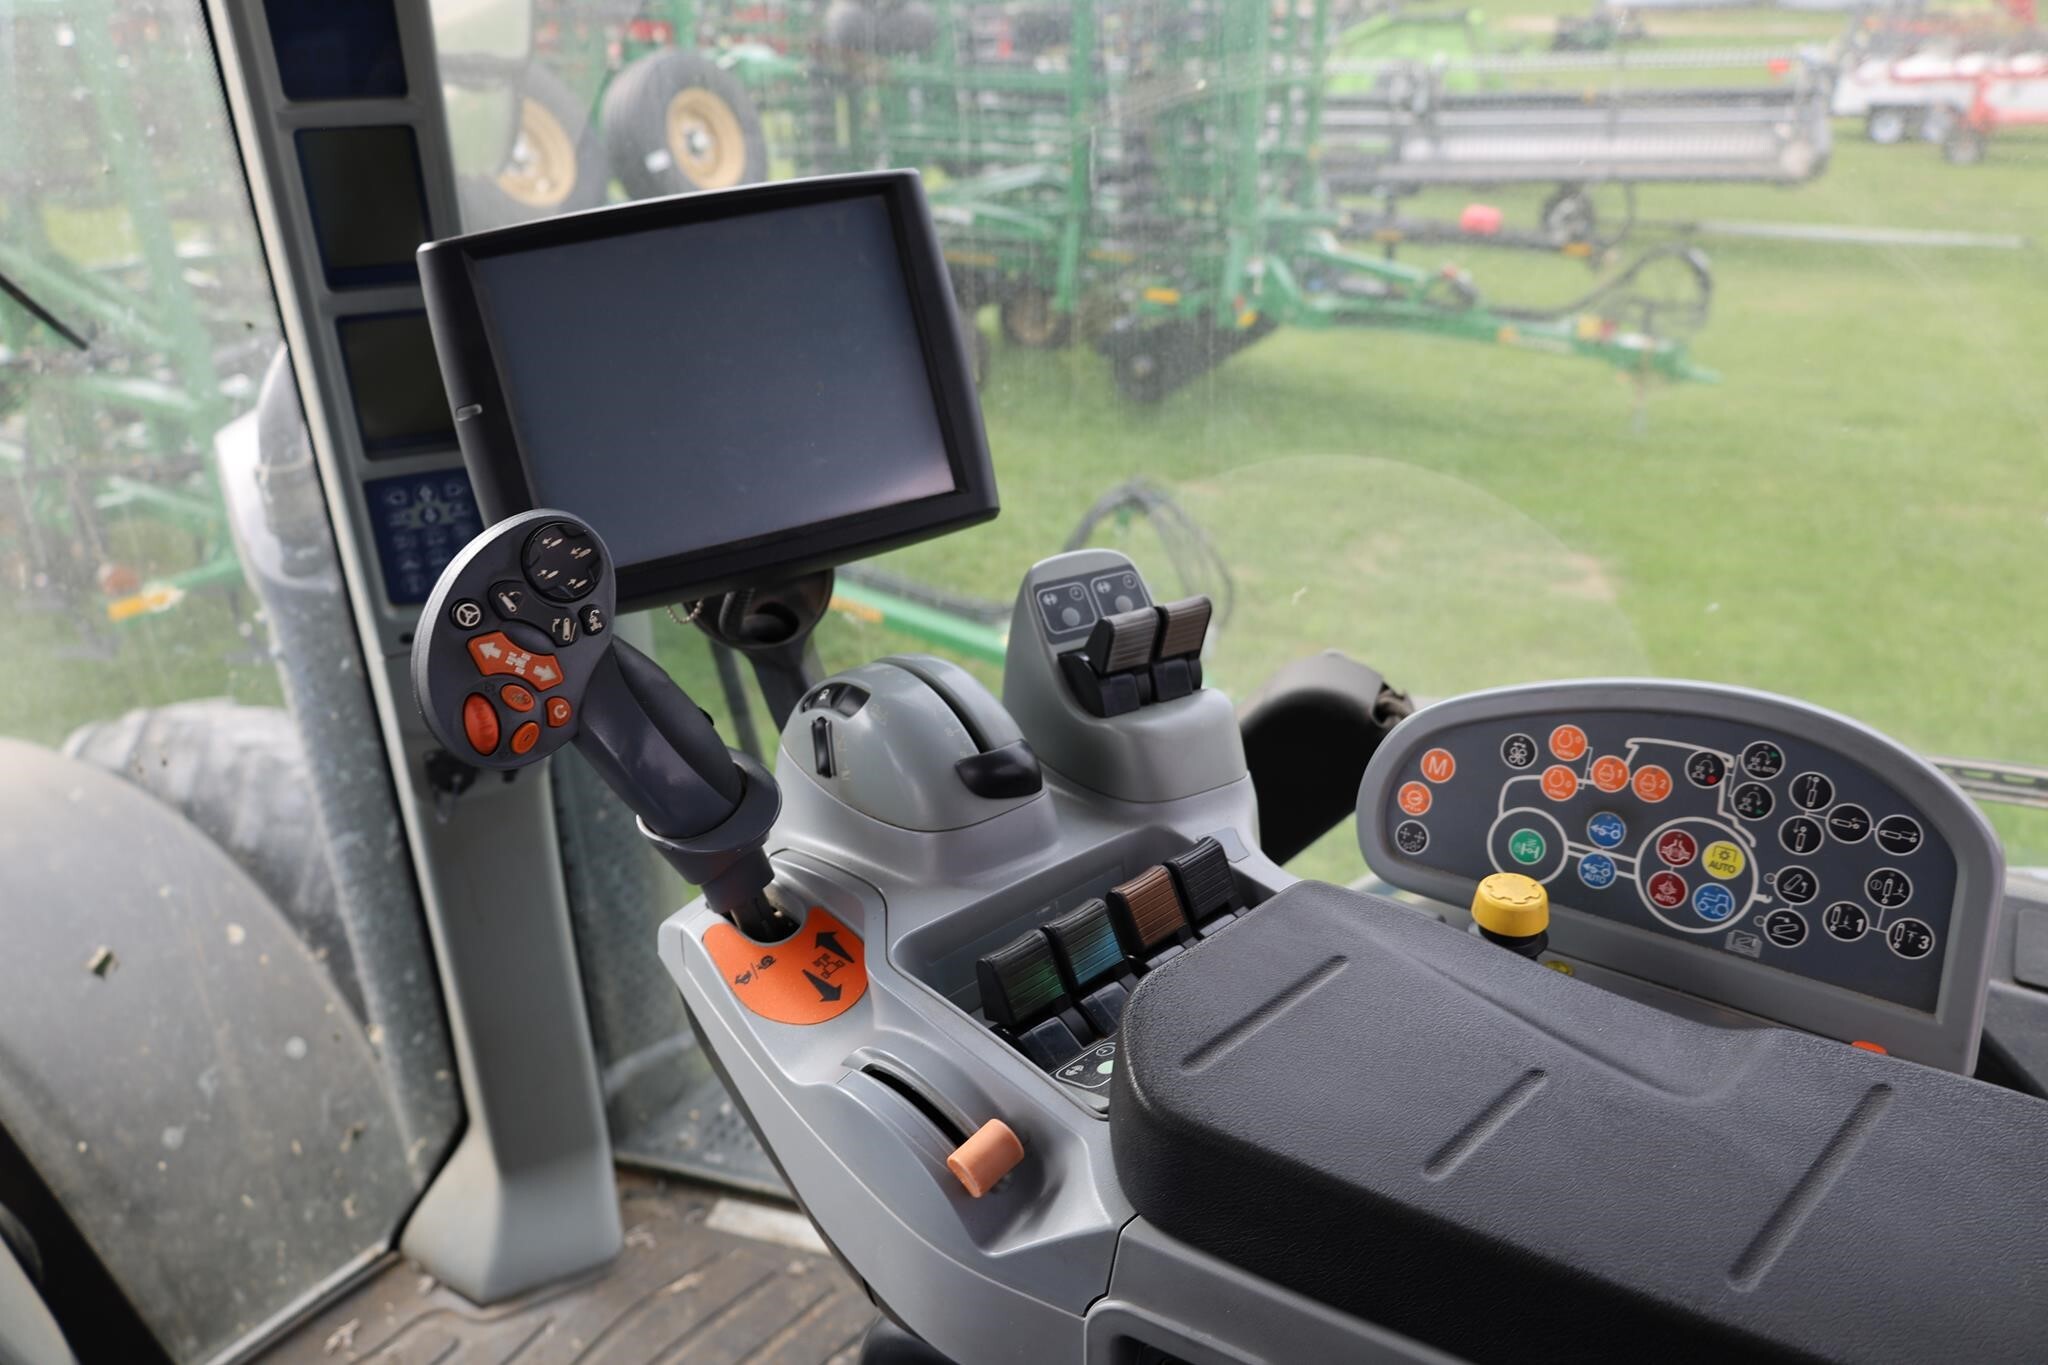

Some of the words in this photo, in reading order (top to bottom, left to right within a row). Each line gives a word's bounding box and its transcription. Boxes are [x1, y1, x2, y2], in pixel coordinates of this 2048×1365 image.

[1428, 756, 1447, 777] M
[1659, 779, 1668, 790] 2
[1708, 860, 1736, 875] AUTO
[1584, 872, 1608, 884] AUTO
[1653, 893, 1677, 905] AUTO
[1856, 918, 1865, 933] 1
[1918, 935, 1930, 950] 3
